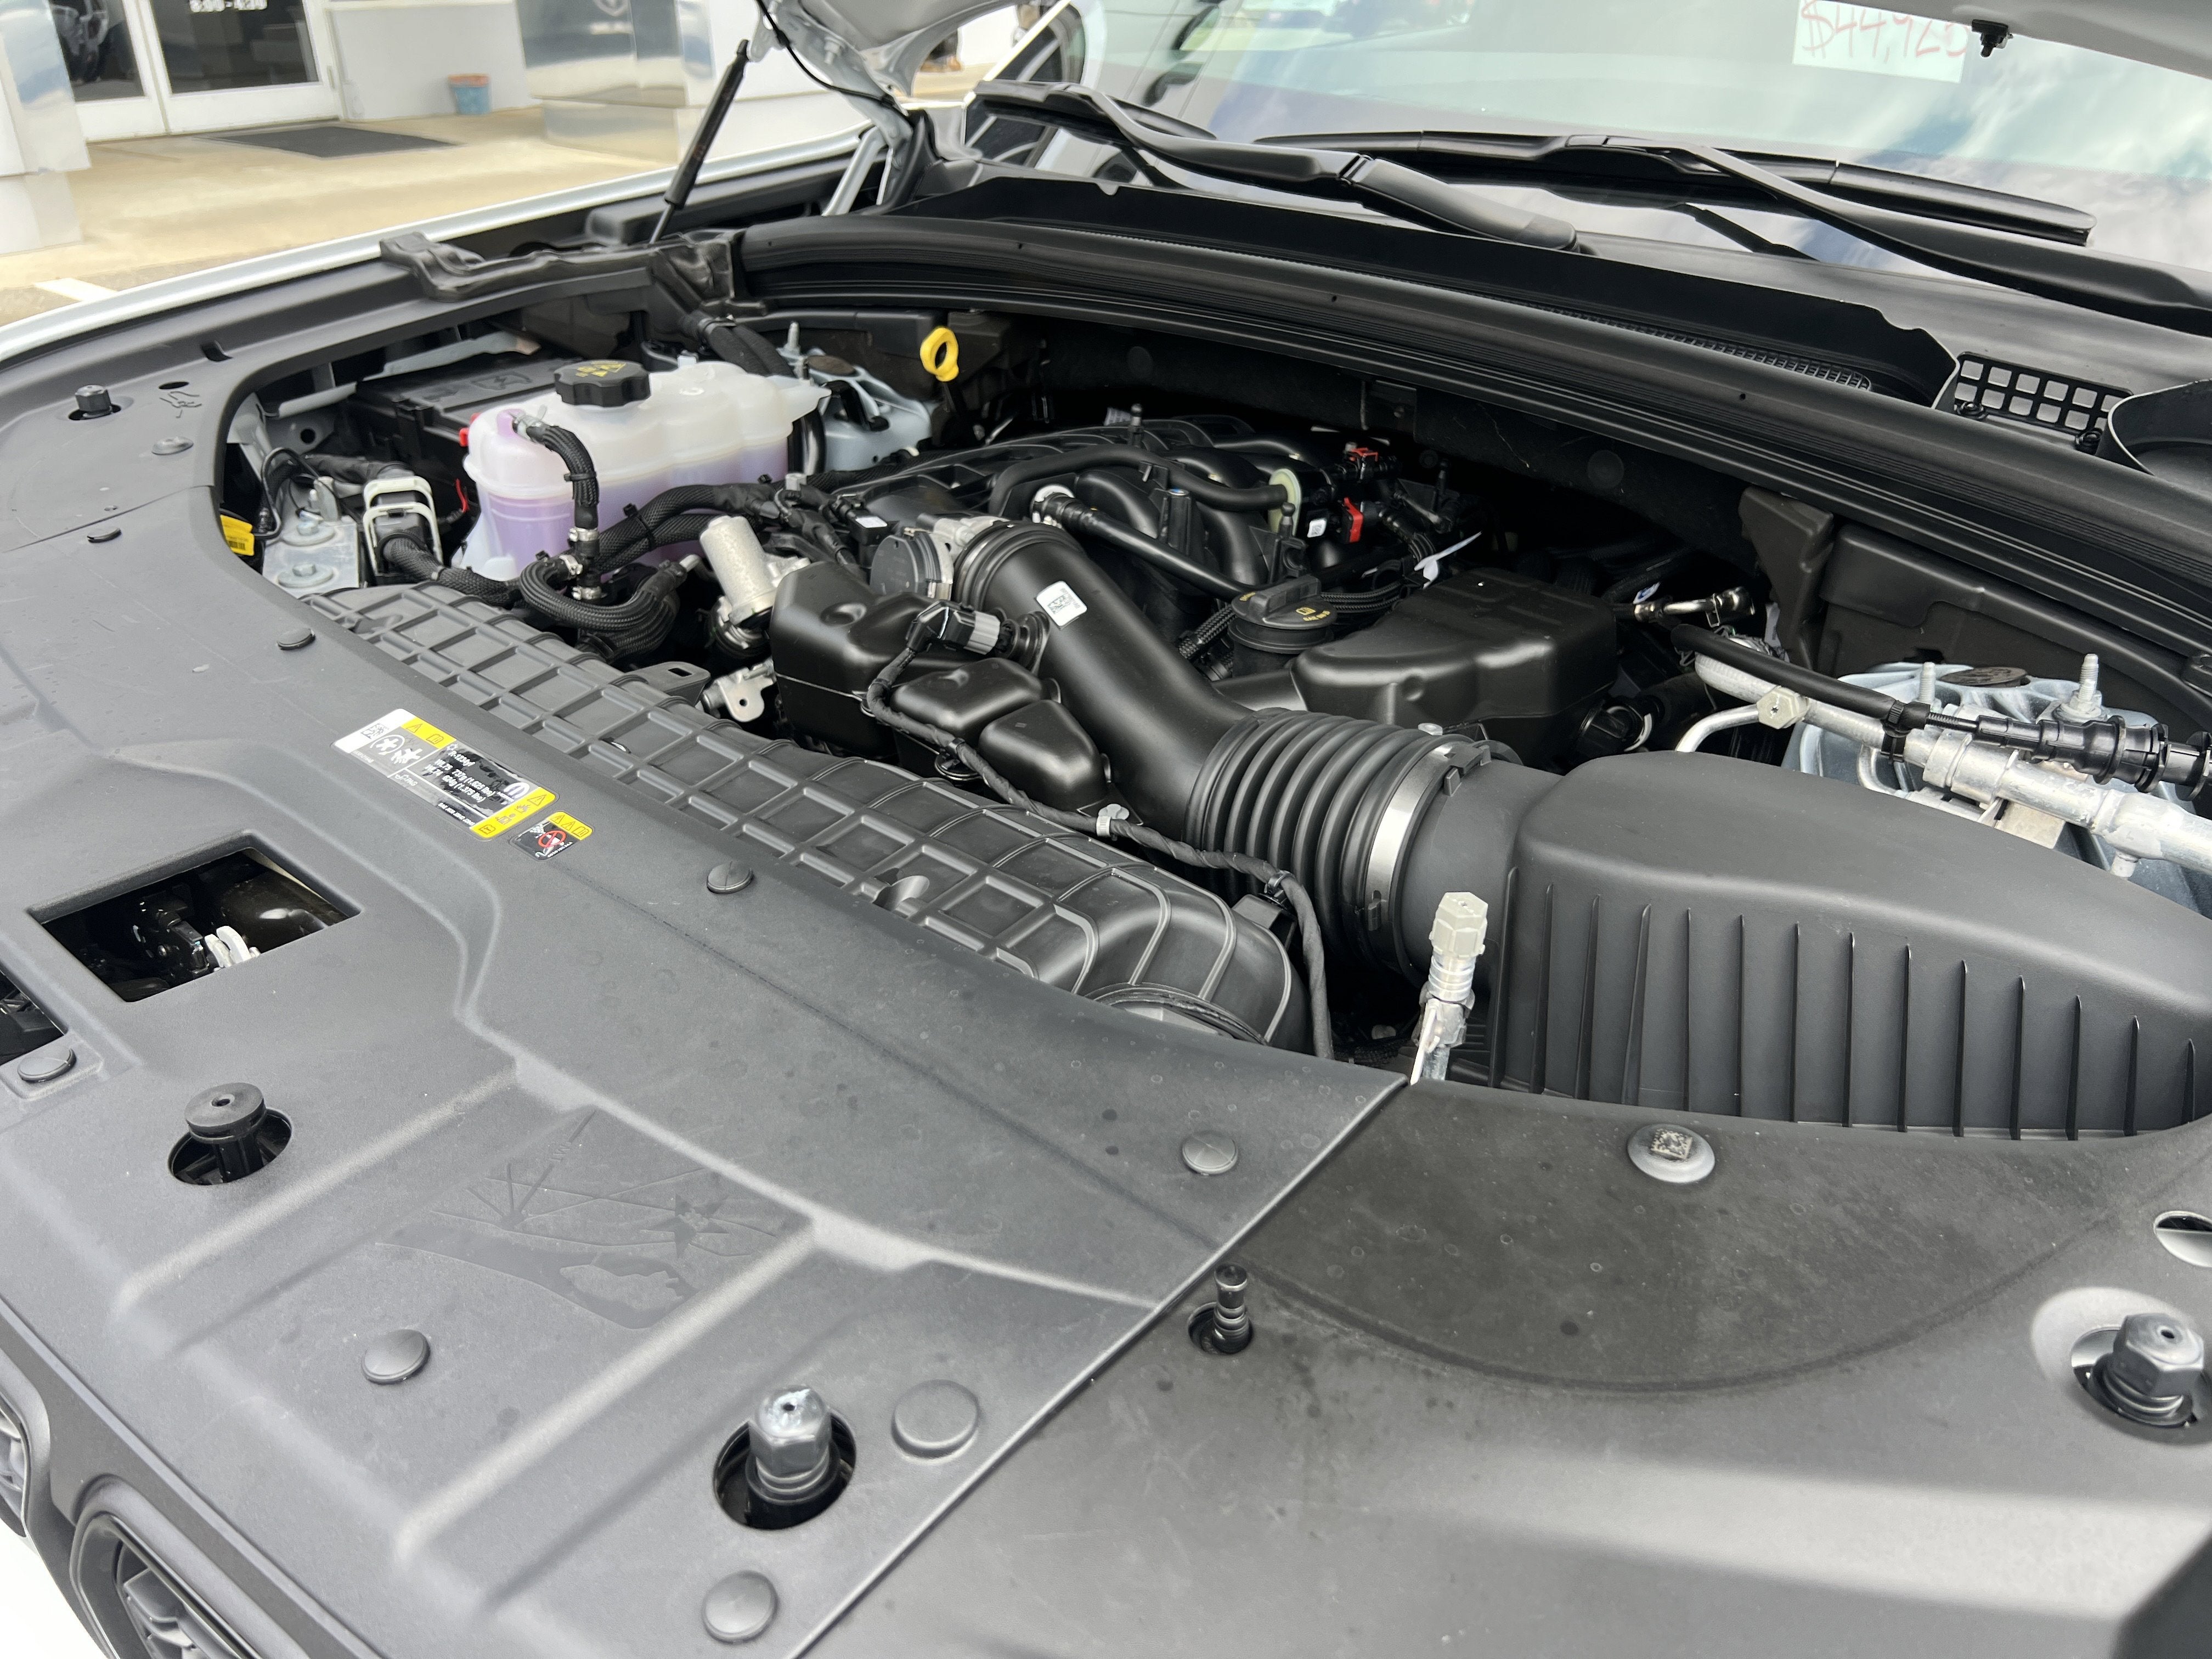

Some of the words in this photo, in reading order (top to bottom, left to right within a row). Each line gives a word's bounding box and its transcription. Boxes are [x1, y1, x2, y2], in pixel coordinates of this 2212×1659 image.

[448, 750, 476, 767] R-1234yf
[435, 758, 453, 771] WL75
[452, 769, 467, 781] 737g
[482, 786, 496, 797] lbs)
[471, 792, 487, 803] lbs)
